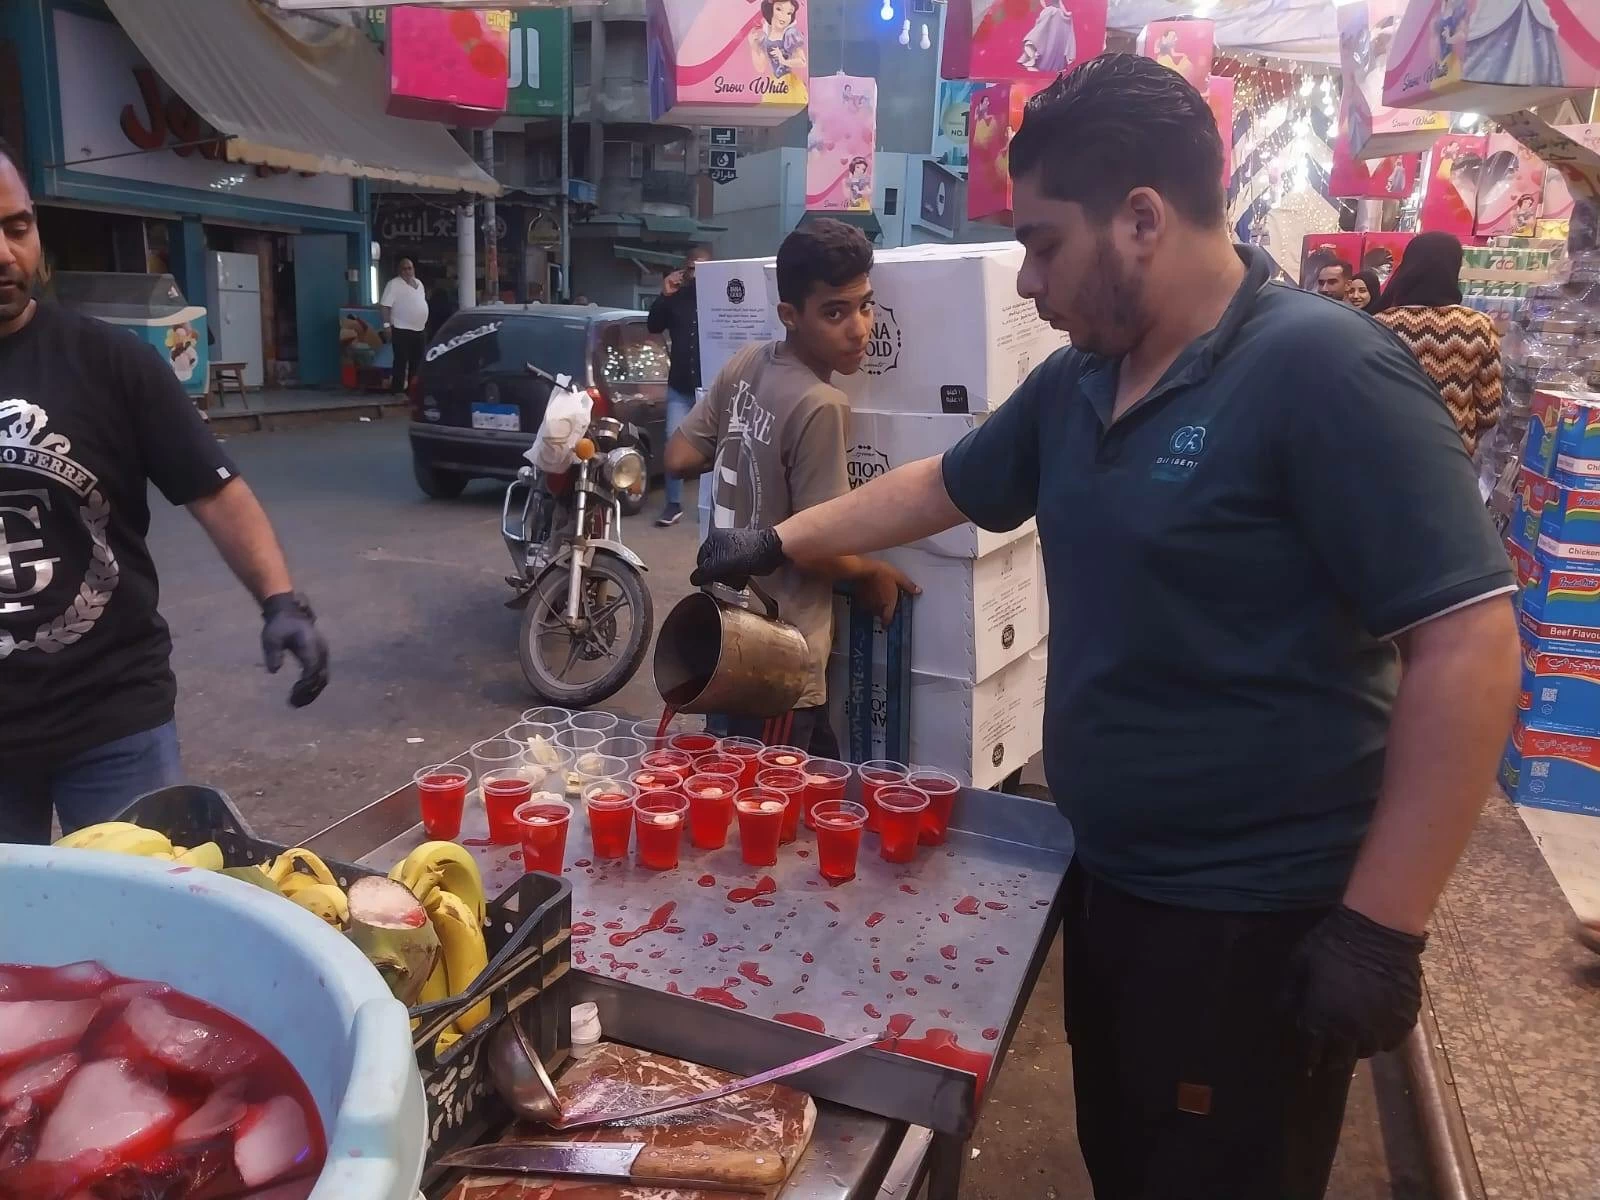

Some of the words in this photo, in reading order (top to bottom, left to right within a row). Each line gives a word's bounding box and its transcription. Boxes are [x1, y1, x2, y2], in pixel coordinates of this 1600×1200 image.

[714, 76, 745, 94] Snow
[749, 77, 789, 95] White
[865, 341, 892, 357] OLD
[22, 449, 89, 487] FERRE
[1550, 627, 1570, 636] Beef
